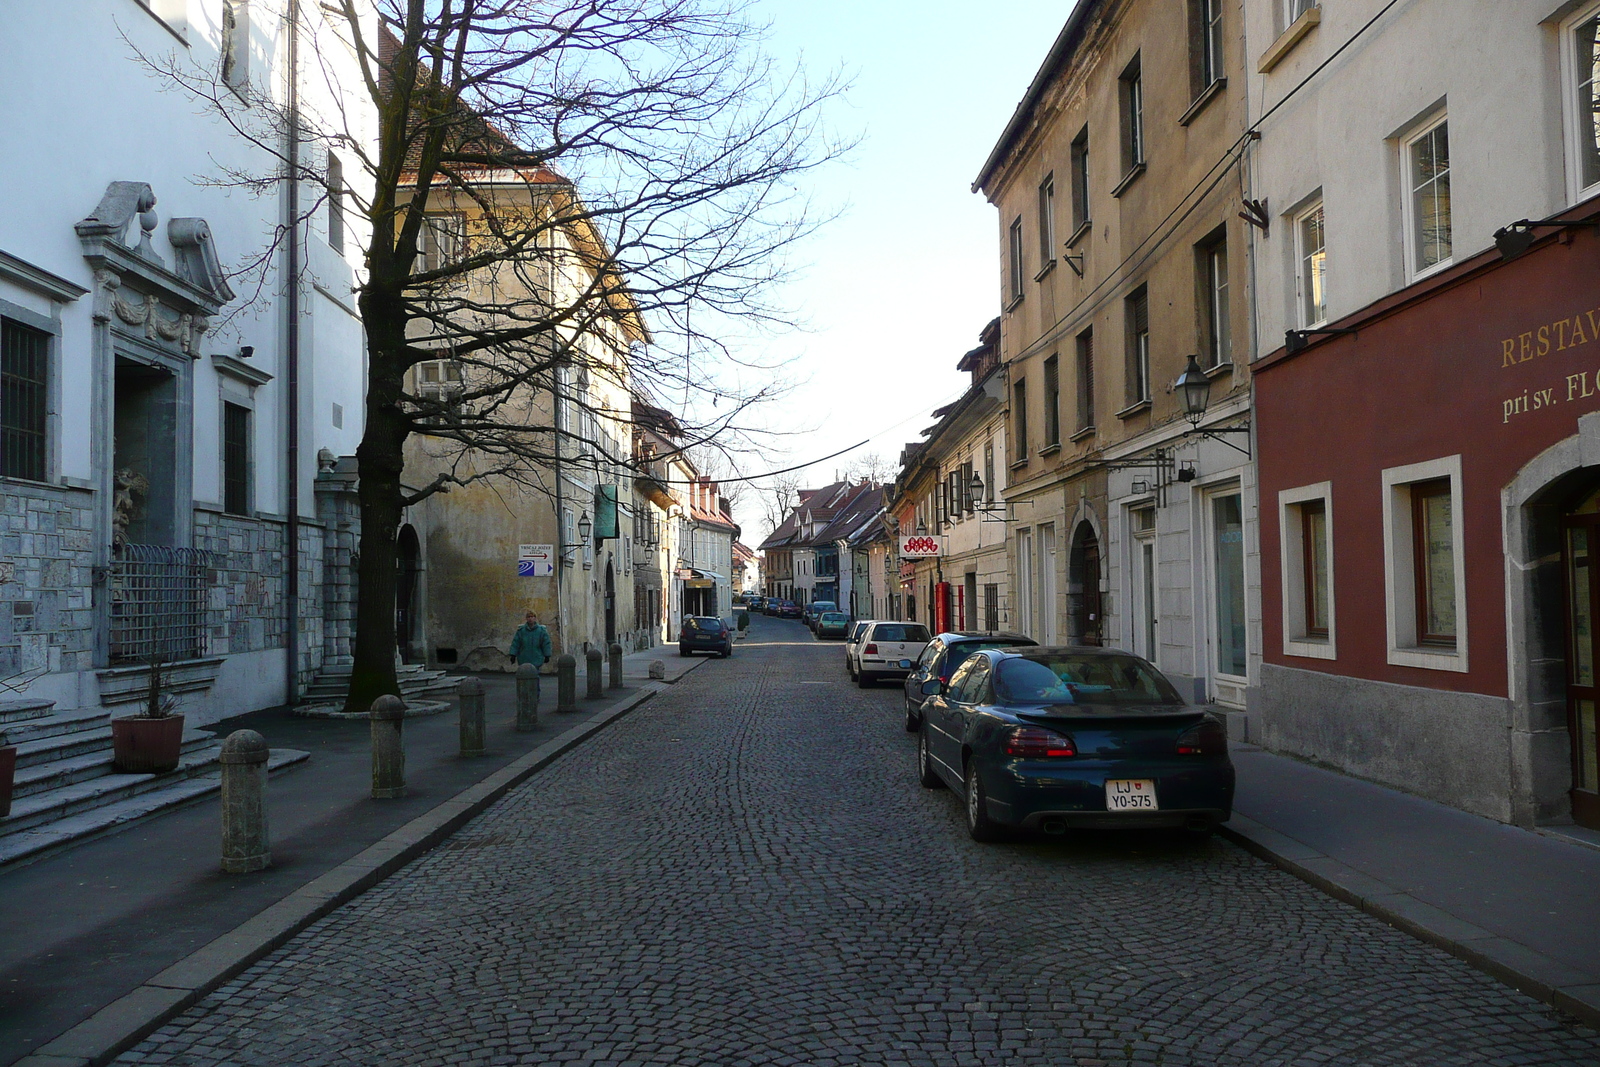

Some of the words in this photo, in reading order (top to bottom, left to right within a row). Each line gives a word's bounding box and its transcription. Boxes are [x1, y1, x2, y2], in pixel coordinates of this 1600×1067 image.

[1502, 389, 1529, 423] pri
[1533, 388, 1557, 410] sv.
[1116, 781, 1130, 793] LJ
